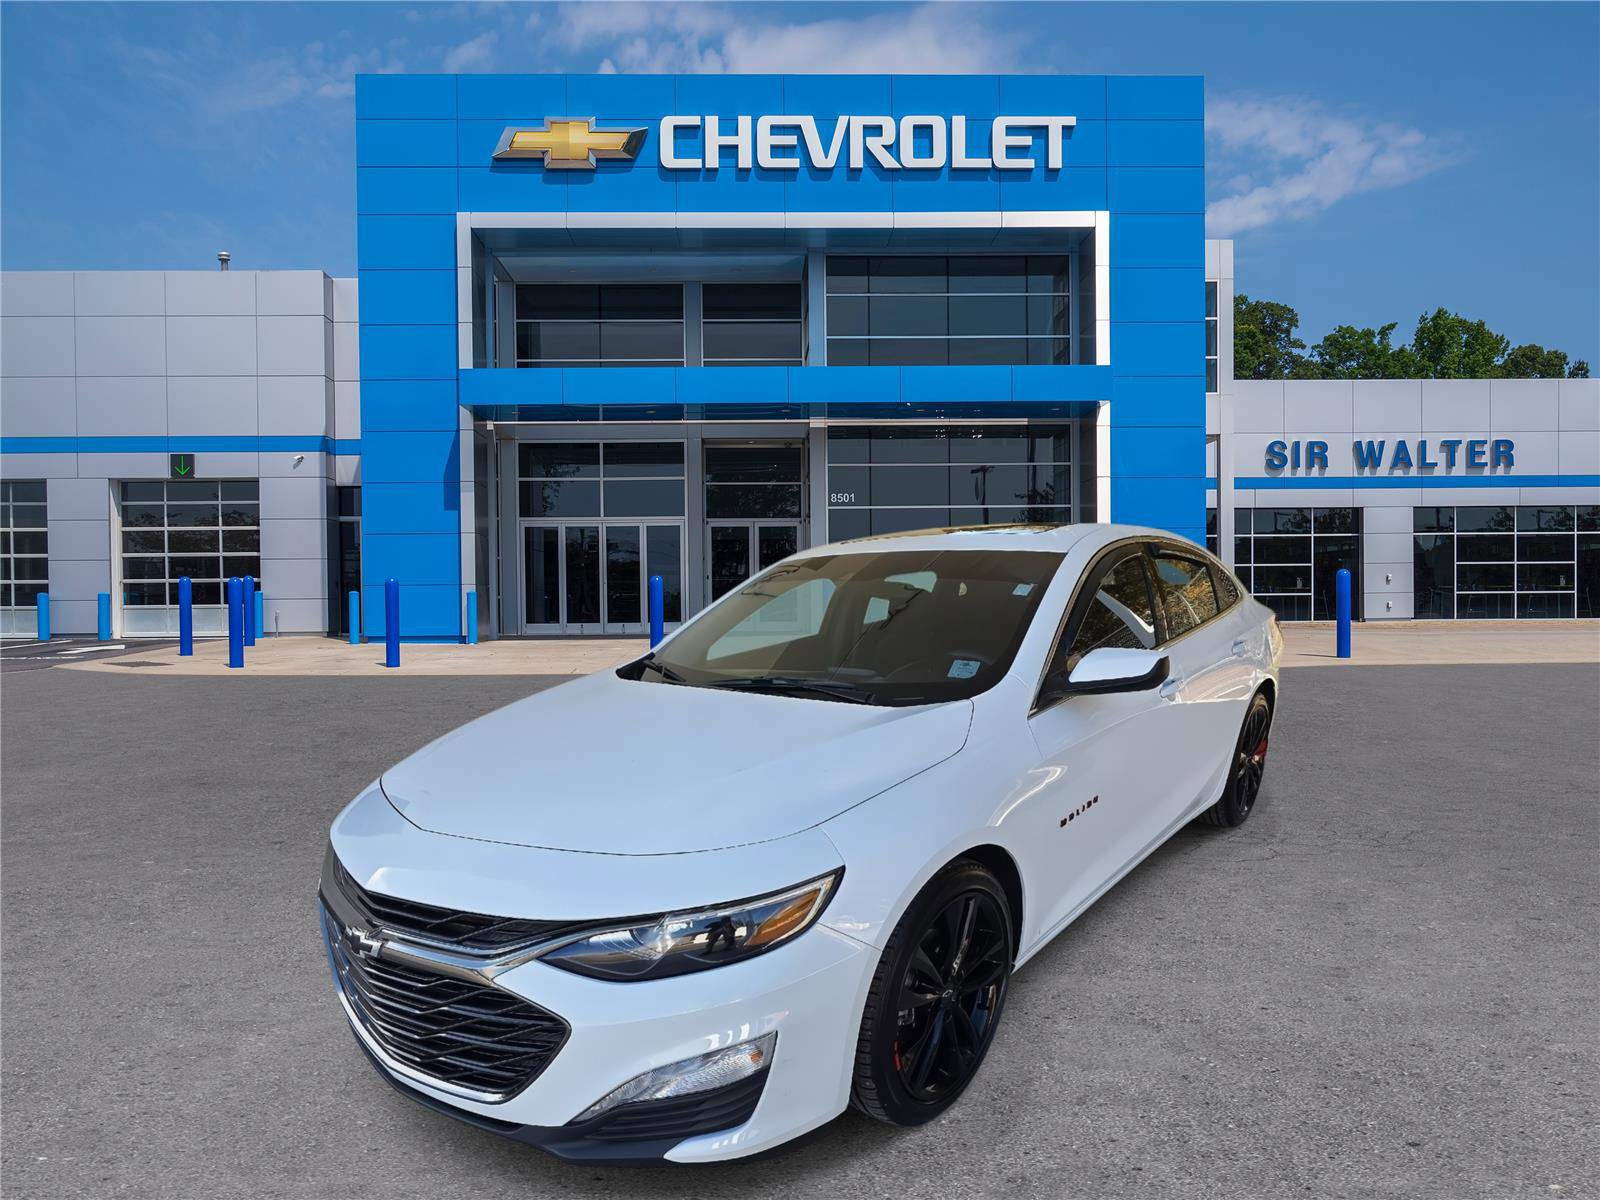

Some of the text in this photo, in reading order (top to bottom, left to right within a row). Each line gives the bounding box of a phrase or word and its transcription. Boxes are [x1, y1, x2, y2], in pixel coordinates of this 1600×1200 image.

[659, 115, 1077, 168] CHEVROLET
[1265, 439, 1515, 469] SIR WALTER
[830, 493, 855, 502] 8501
